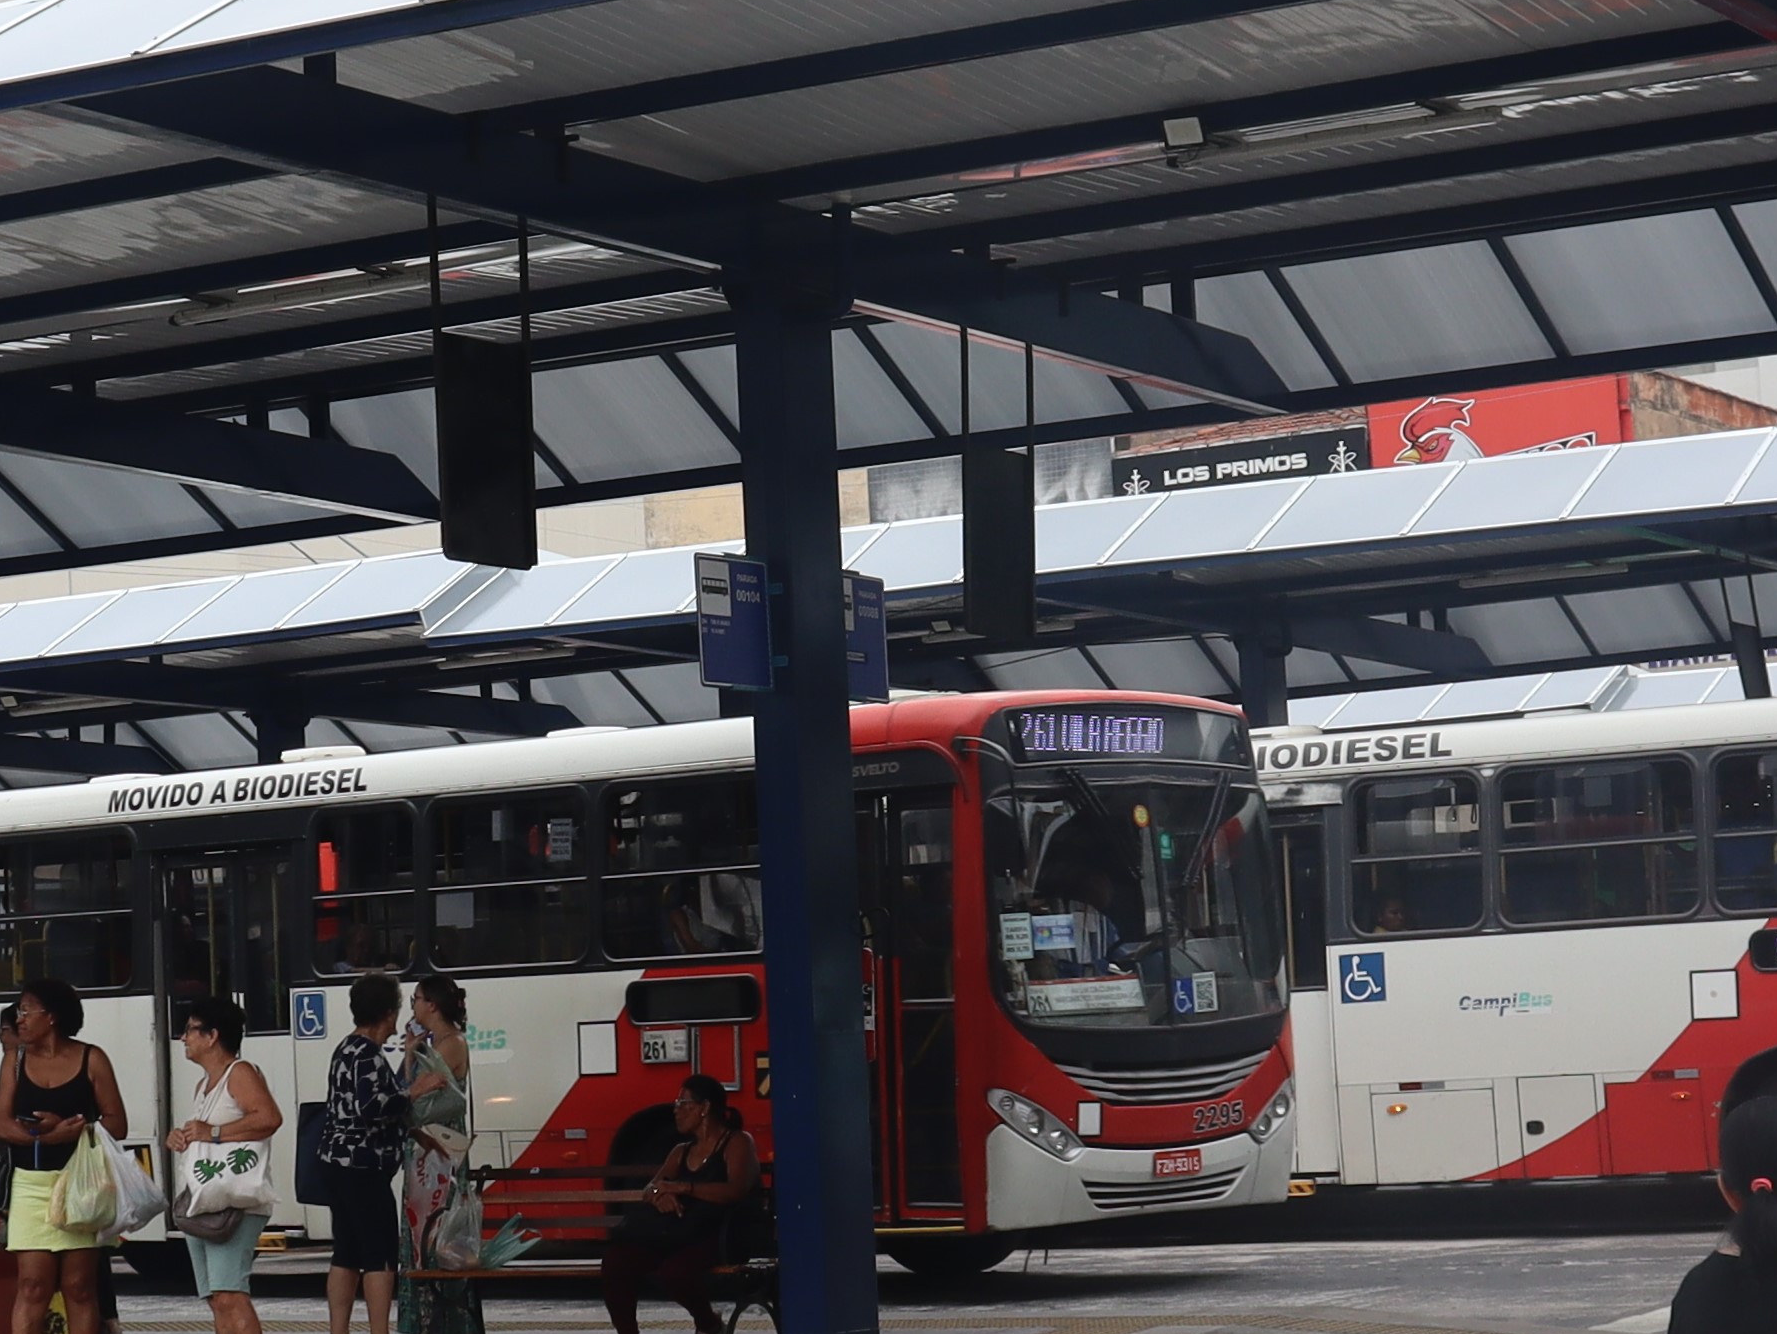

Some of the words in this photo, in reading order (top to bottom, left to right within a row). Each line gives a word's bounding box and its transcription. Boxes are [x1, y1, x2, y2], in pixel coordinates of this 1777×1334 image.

[1163, 465, 1211, 487] LOS
[1215, 452, 1308, 480] PRIMOS
[735, 589, 761, 603] 00104
[1256, 732, 1453, 771] IODIESEL
[108, 781, 205, 814] MOVIDO
[209, 779, 227, 804] A
[232, 767, 368, 802] BIODIESEL
[643, 1040, 667, 1060] 261
[1192, 1099, 1243, 1134] 2295
